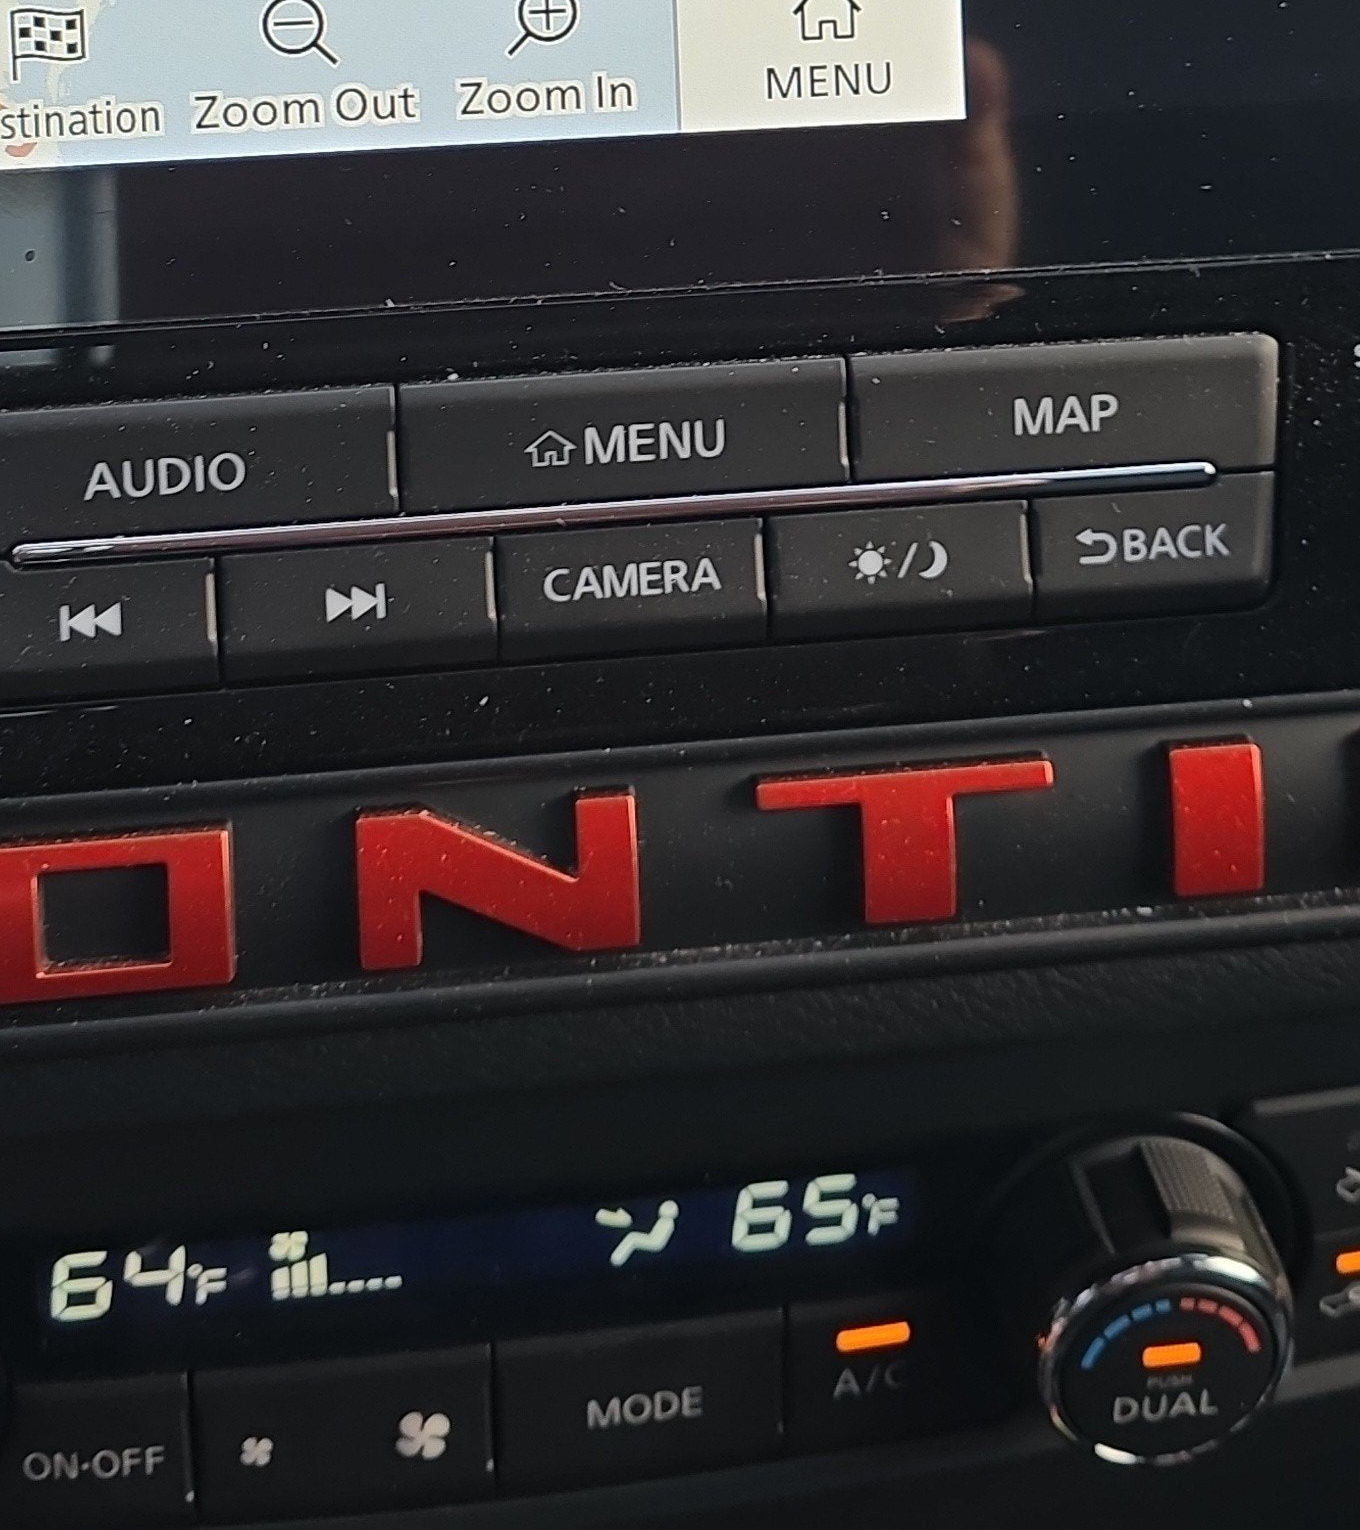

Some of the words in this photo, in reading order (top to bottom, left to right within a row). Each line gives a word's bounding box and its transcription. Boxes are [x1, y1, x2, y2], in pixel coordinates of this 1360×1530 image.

[459, 80, 581, 116] Zoom
[597, 76, 634, 110] In
[766, 61, 893, 100] MENU
[194, 95, 321, 130] Zoom
[336, 87, 416, 123] Out
[1012, 393, 1119, 437] MAP
[583, 418, 727, 466] MENU
[83, 452, 247, 501] AUDIO
[1123, 522, 1232, 563] BACK
[543, 556, 722, 603] CAMERA
[832, 1361, 906, 1401] A/C
[586, 1385, 704, 1431] MODE
[1112, 1388, 1219, 1424] DUAL
